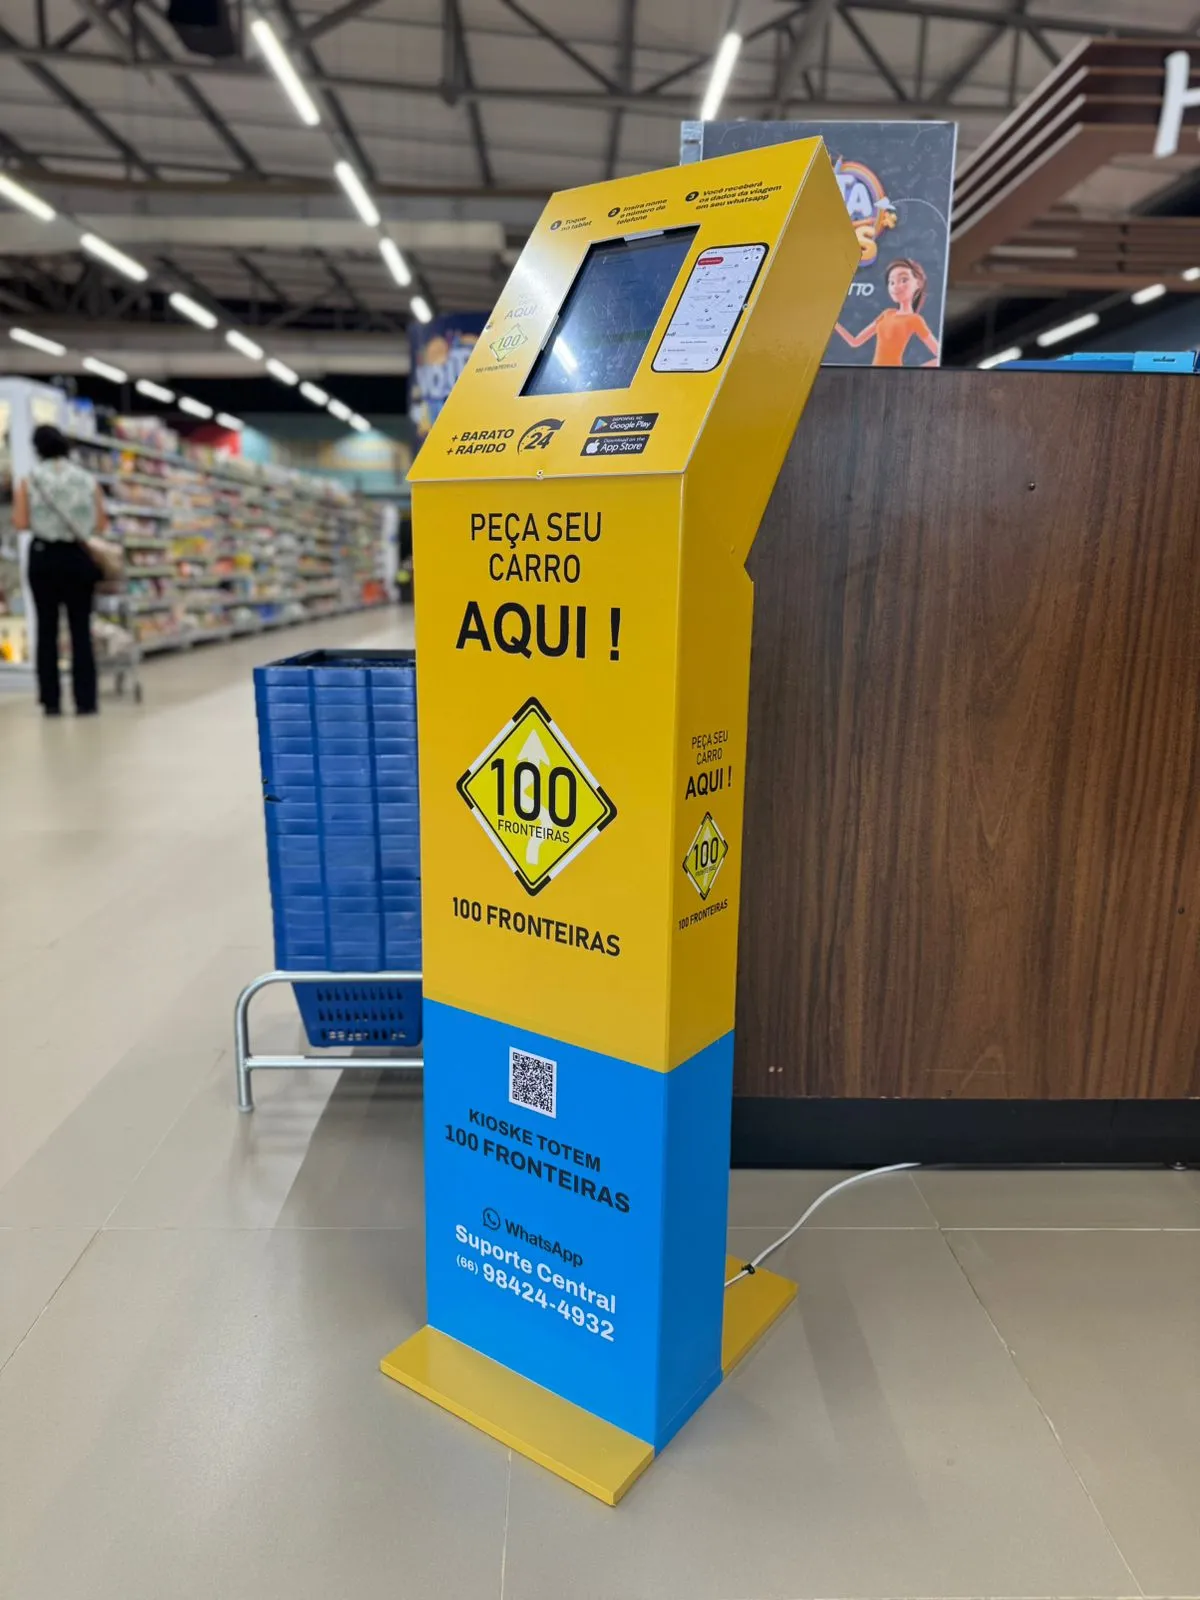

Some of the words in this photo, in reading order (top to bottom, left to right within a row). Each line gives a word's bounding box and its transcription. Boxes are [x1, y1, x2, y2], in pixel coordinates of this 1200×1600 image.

[703, 187, 724, 196] Você
[724, 181, 763, 192] receberá
[710, 192, 736, 202] dados
[737, 189, 749, 197] da
[750, 185, 782, 195] viagem
[623, 203, 645, 212] Insira
[645, 199, 668, 207] nome
[695, 202, 709, 210] em
[710, 200, 726, 208] seu
[727, 194, 769, 206] whatsapp
[565, 217, 587, 225] Toque
[616, 214, 648, 225] telefone
[626, 207, 655, 217] número
[571, 221, 592, 230] tablet
[498, 334, 522, 351] 100
[609, 421, 635, 430] Google
[635, 420, 652, 429] Play
[451, 434, 459, 443] +
[460, 428, 515, 442] BARATO
[523, 431, 556, 450] 24
[446, 447, 453, 456] +
[455, 440, 507, 455] RÁPIDO
[600, 443, 619, 453] App
[619, 442, 643, 451] Store
[471, 512, 540, 549] PEÇA
[546, 512, 602, 542] SEU
[489, 553, 581, 583] CARRO
[456, 601, 586, 659] AQUI
[610, 607, 621, 661] !
[691, 734, 712, 750] PEÇA
[713, 730, 728, 745] SEU
[696, 747, 722, 765] CARRO
[685, 767, 724, 800] AQUI
[727, 765, 732, 788] !
[490, 758, 577, 828] 100
[498, 819, 570, 844] FRONTEIRAS
[694, 837, 719, 871] 100
[679, 917, 690, 930] 100
[689, 899, 728, 923] FRONTEIRAS
[453, 896, 482, 922] 100
[487, 905, 621, 957] FRONTEIRAS
[469, 1108, 533, 1146] KIOSKE
[536, 1134, 601, 1173] TOTEM
[445, 1124, 479, 1152] 100
[483, 1138, 630, 1213] FRONTEIRAS
[504, 1218, 584, 1268] WhatsApp
[455, 1224, 533, 1275] Suporte
[536, 1263, 616, 1314] Central
[456, 1254, 479, 1276] (66)
[483, 1263, 615, 1342] 98424-4932
